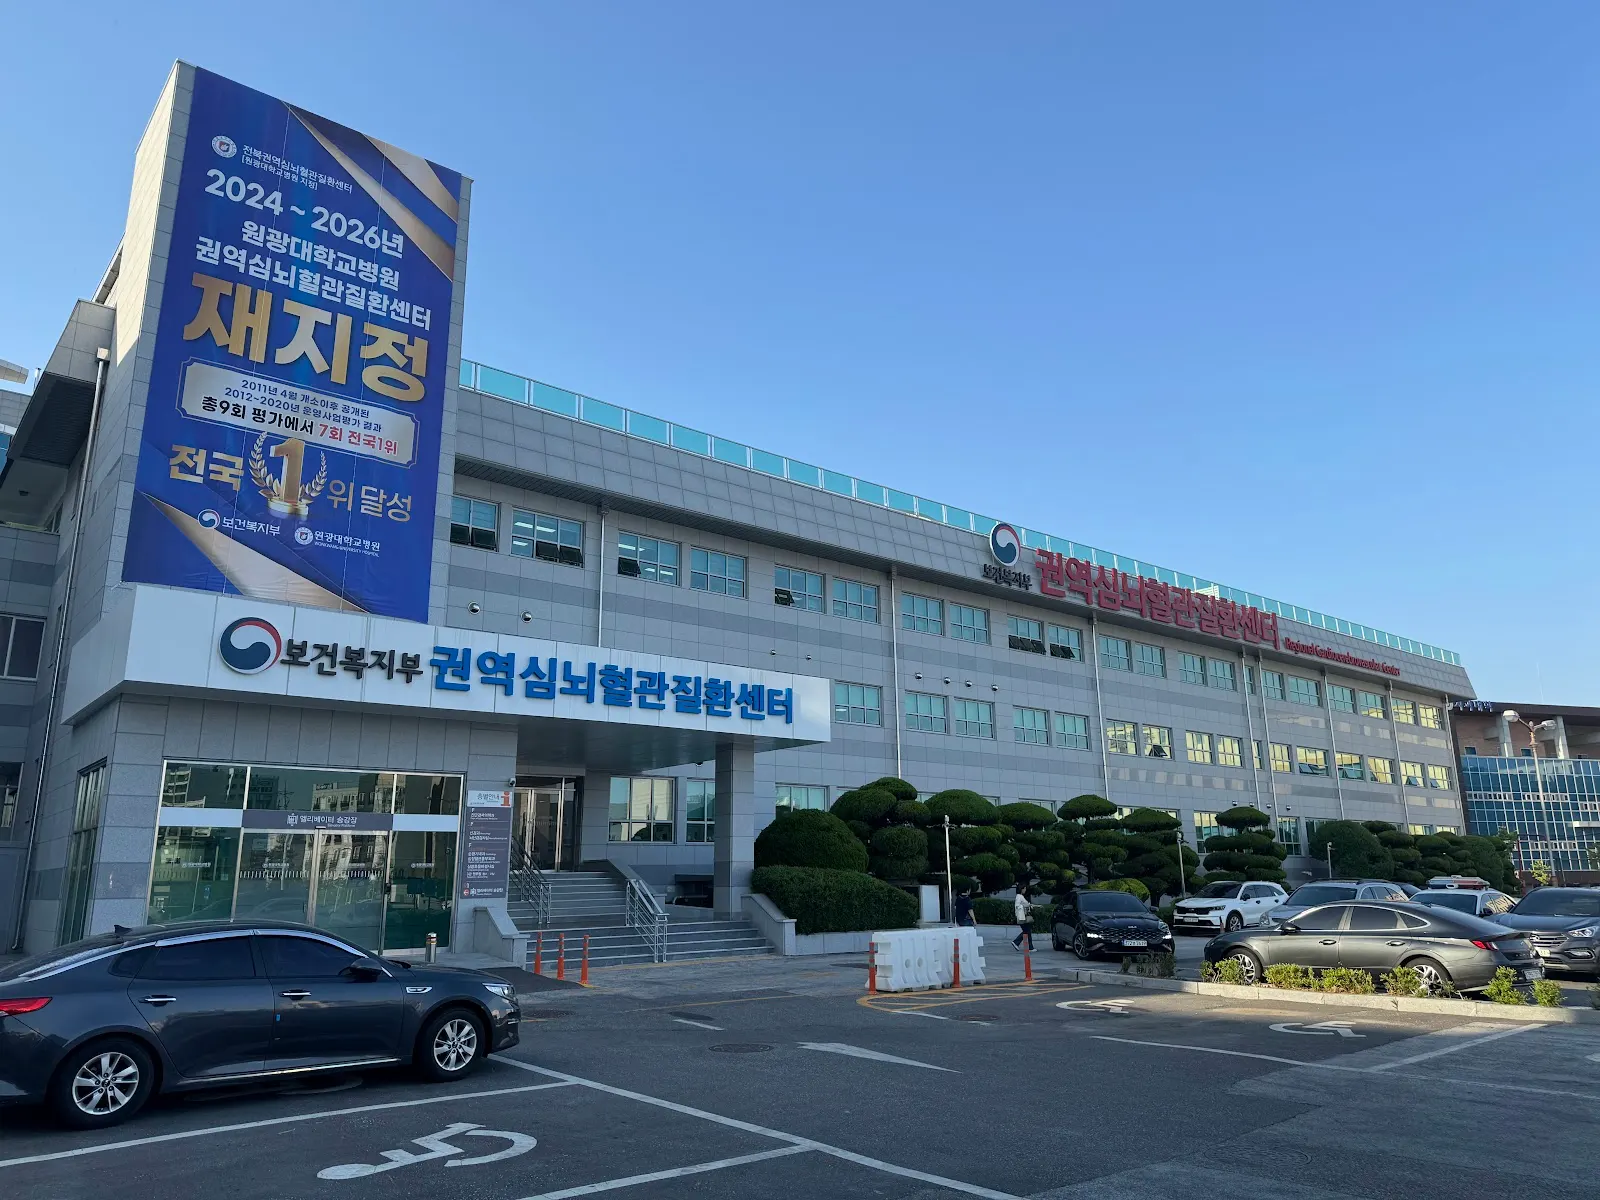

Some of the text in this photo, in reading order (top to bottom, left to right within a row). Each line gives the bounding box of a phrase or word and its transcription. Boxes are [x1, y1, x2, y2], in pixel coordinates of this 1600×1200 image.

[243, 144, 353, 194] 전북권역심뇌혈관질환센터
[204, 168, 404, 259] 2024 ~ 2026년
[195, 236, 432, 331] 권역심뇌혈관질환센터
[241, 220, 401, 292] 원광대학교병원
[182, 271, 429, 402] 재지정
[201, 395, 398, 455] 총9회 평가에서 7회 전국1위
[224, 387, 382, 433] 2012~2020년 운영사업평가 결과
[241, 379, 370, 419] 2011년 4월 개소이후 공개된
[169, 438, 412, 522] 전국 1 위 달성
[222, 517, 281, 537] 보건복지부
[314, 530, 380, 552] 원광대학교병원
[983, 547, 1281, 650] 보건복지부 권역심뇌혈관질환센터
[1284, 637, 1315, 655] Regional
[280, 638, 795, 725] 보건복지부 권역심뇌혈관질환센터
[299, 815, 358, 825] 엘리베이터 승강장
